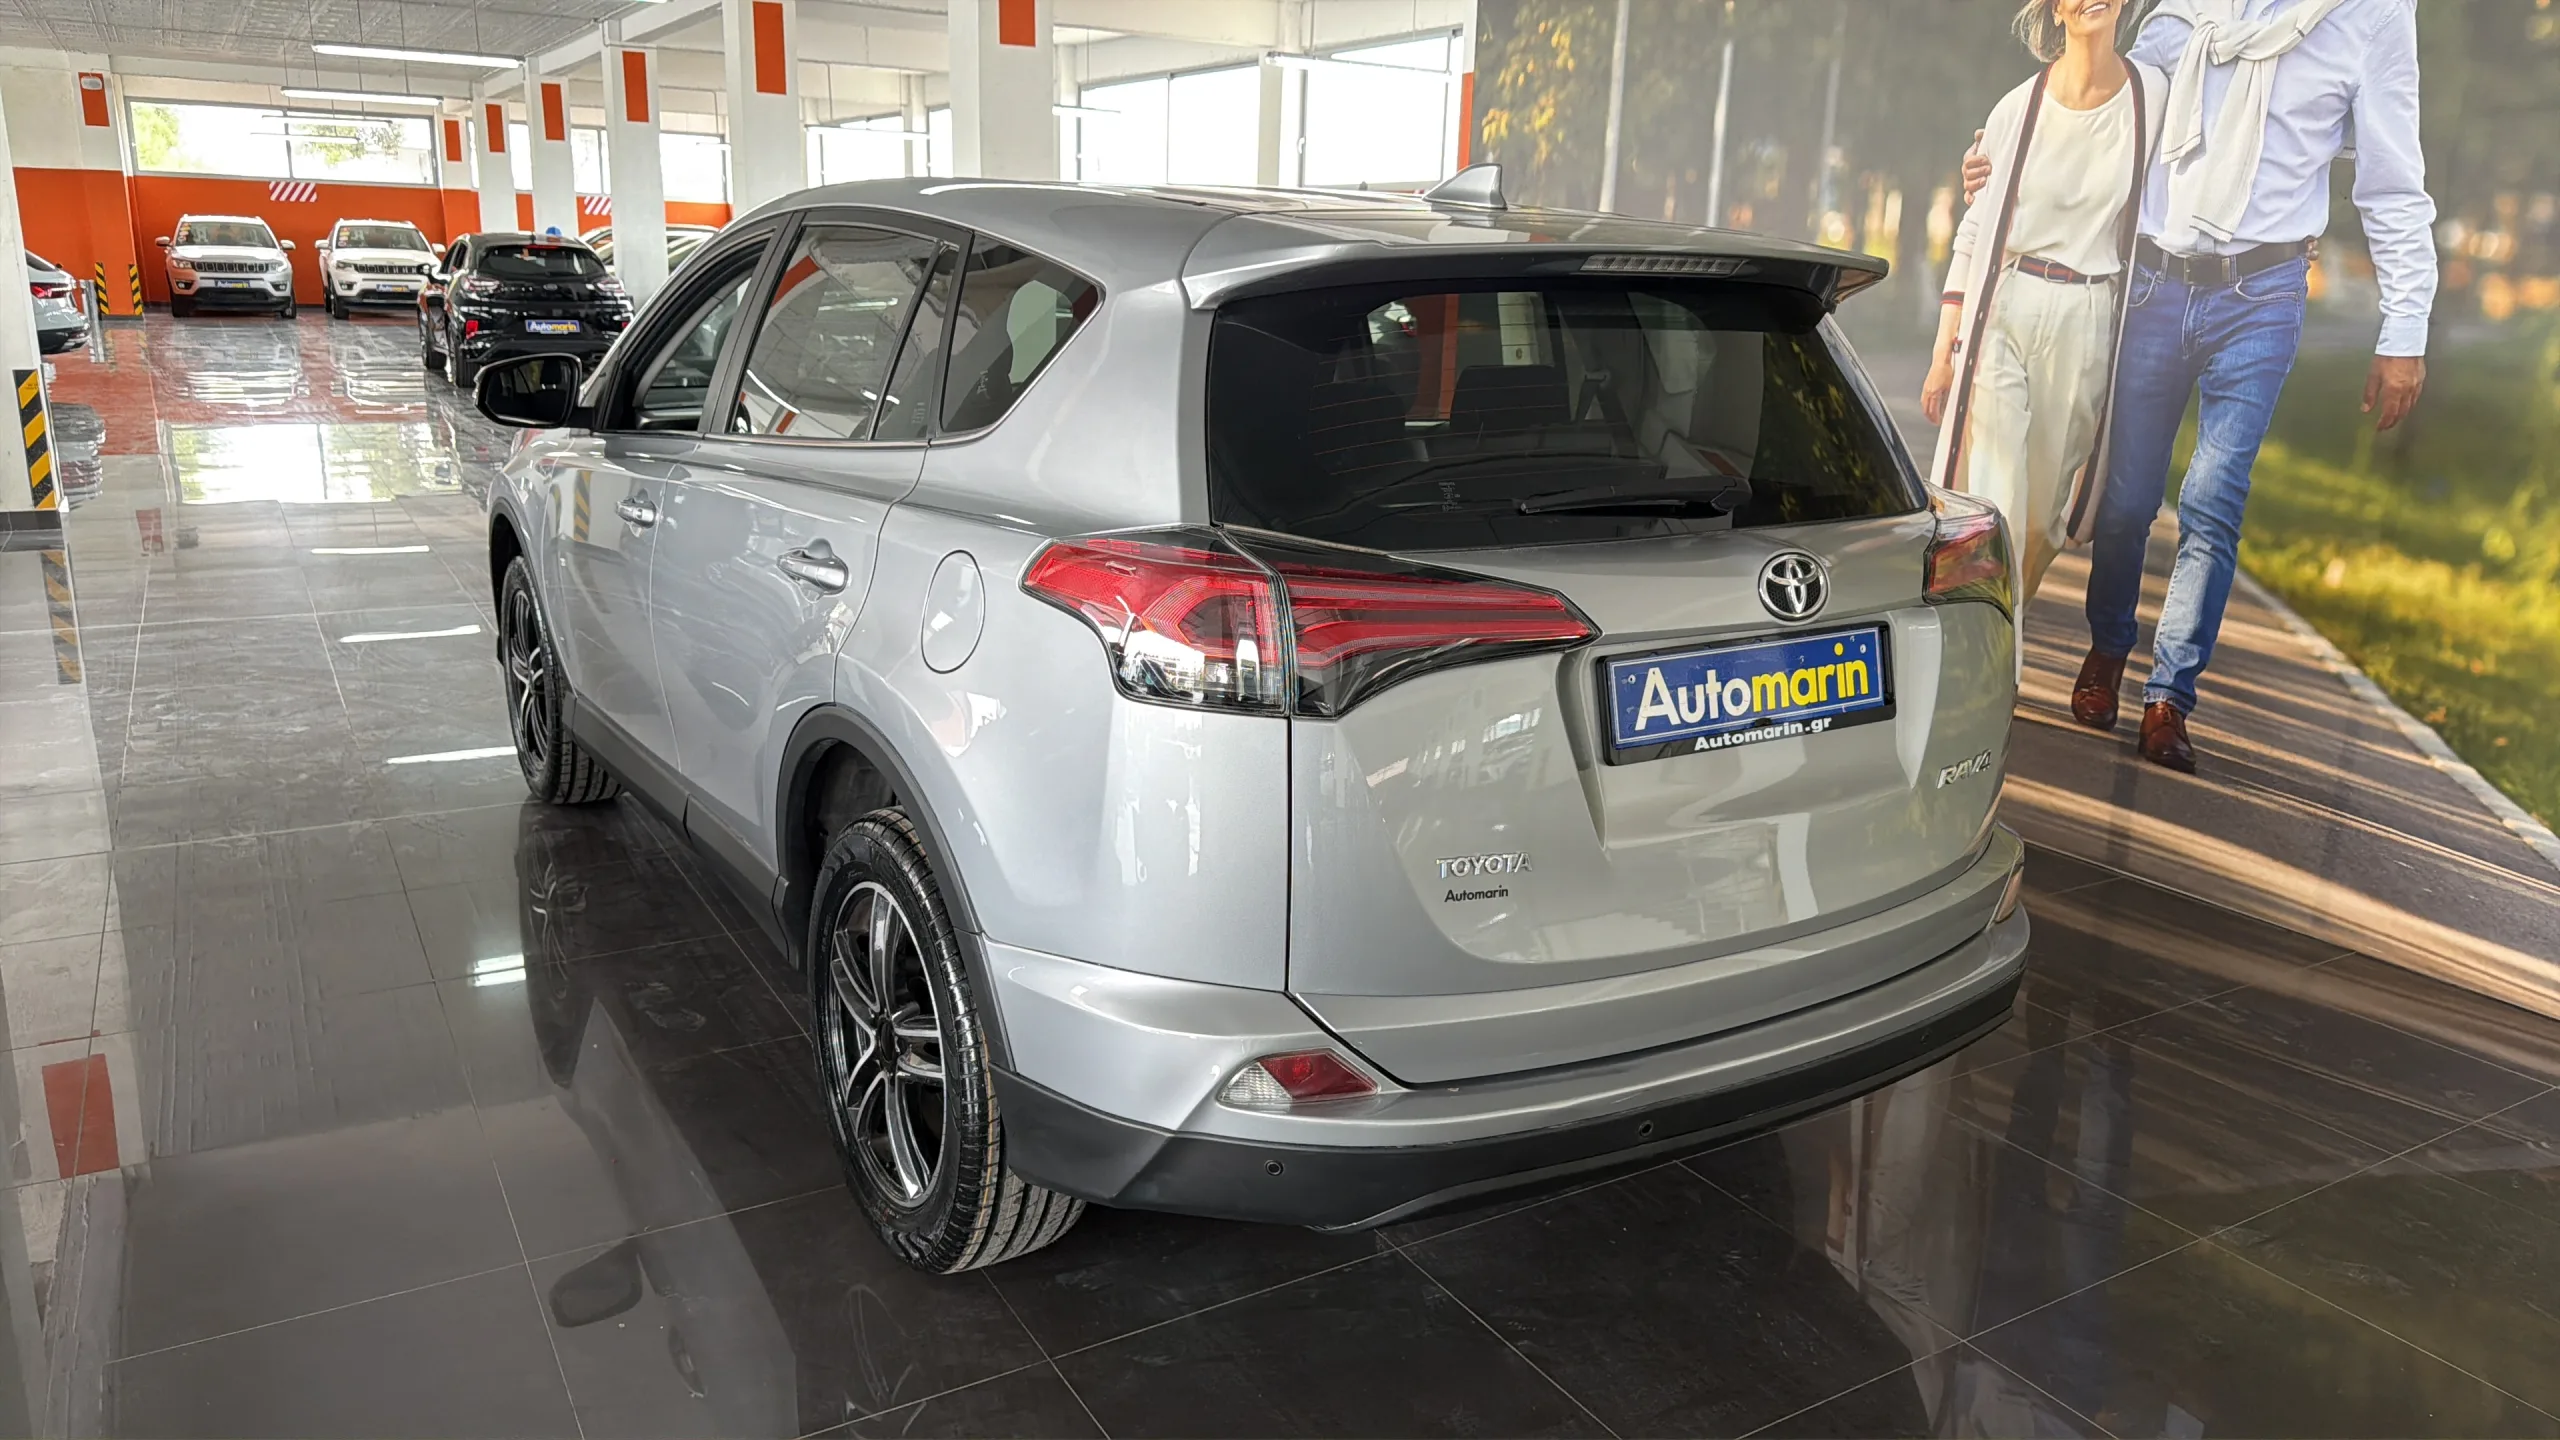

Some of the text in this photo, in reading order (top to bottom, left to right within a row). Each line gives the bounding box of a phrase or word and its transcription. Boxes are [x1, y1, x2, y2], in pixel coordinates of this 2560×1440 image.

[529, 321, 577, 331] Automarin
[1634, 642, 1870, 731] Automarin
[1694, 716, 1832, 751] Automarin.gr
[1936, 749, 1991, 789] RAV4
[1436, 852, 1533, 879] TOYOTA
[1444, 885, 1509, 903] Automarin
